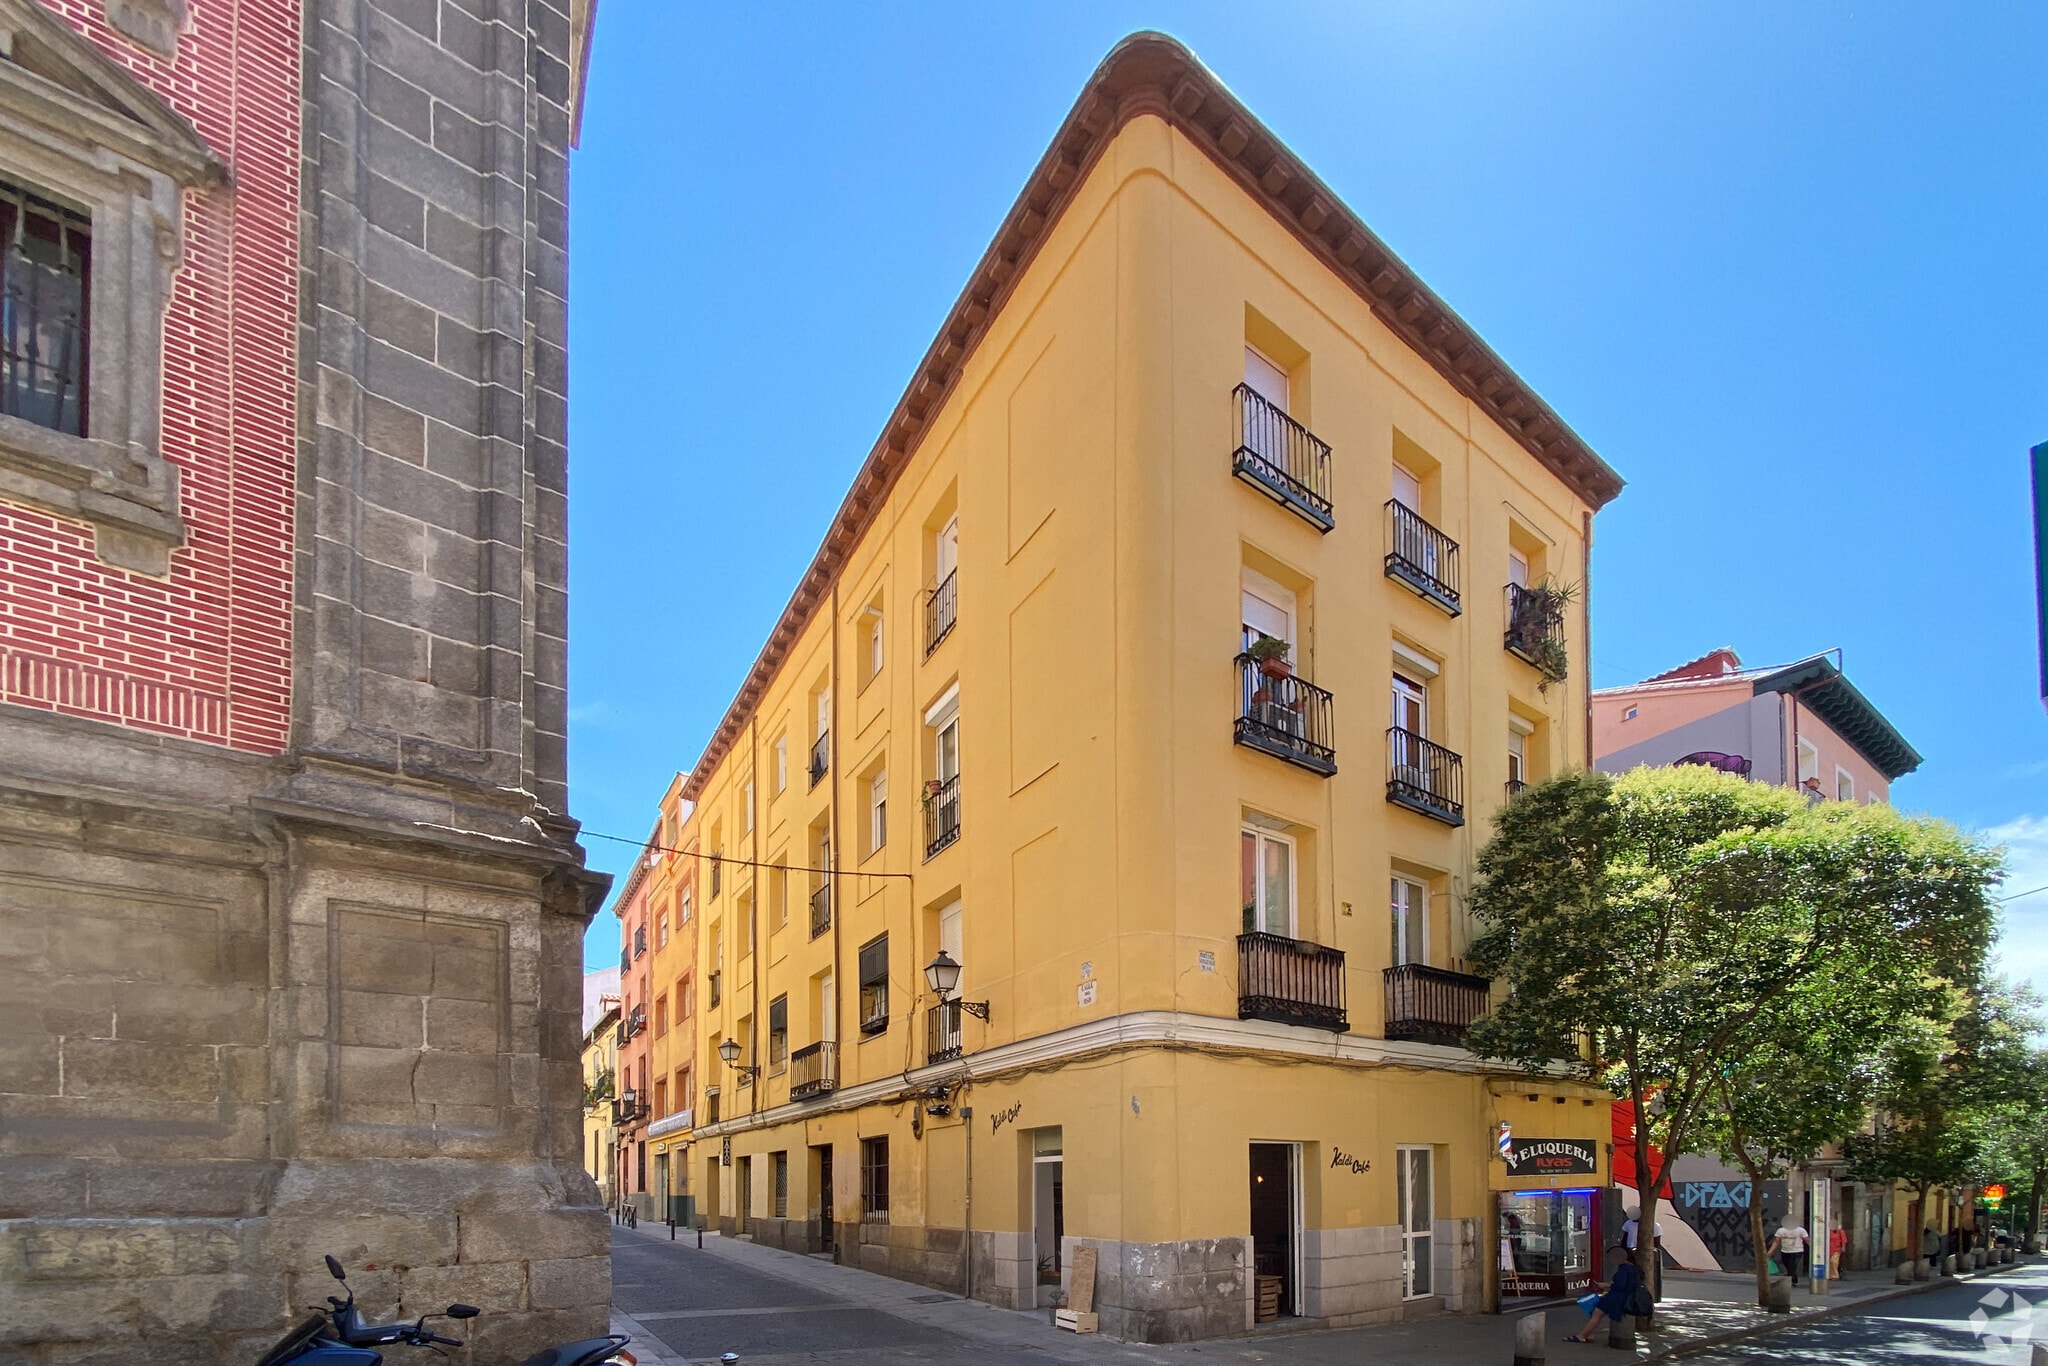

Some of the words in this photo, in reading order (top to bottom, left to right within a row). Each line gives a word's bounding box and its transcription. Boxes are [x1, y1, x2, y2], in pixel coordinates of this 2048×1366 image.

[1330, 1146, 1352, 1168] Kaldi
[1351, 1160, 1371, 1174] Café
[1508, 1142, 1594, 1169] PELUQUERIA
[1501, 1282, 1550, 1291] ELUQUERIA
